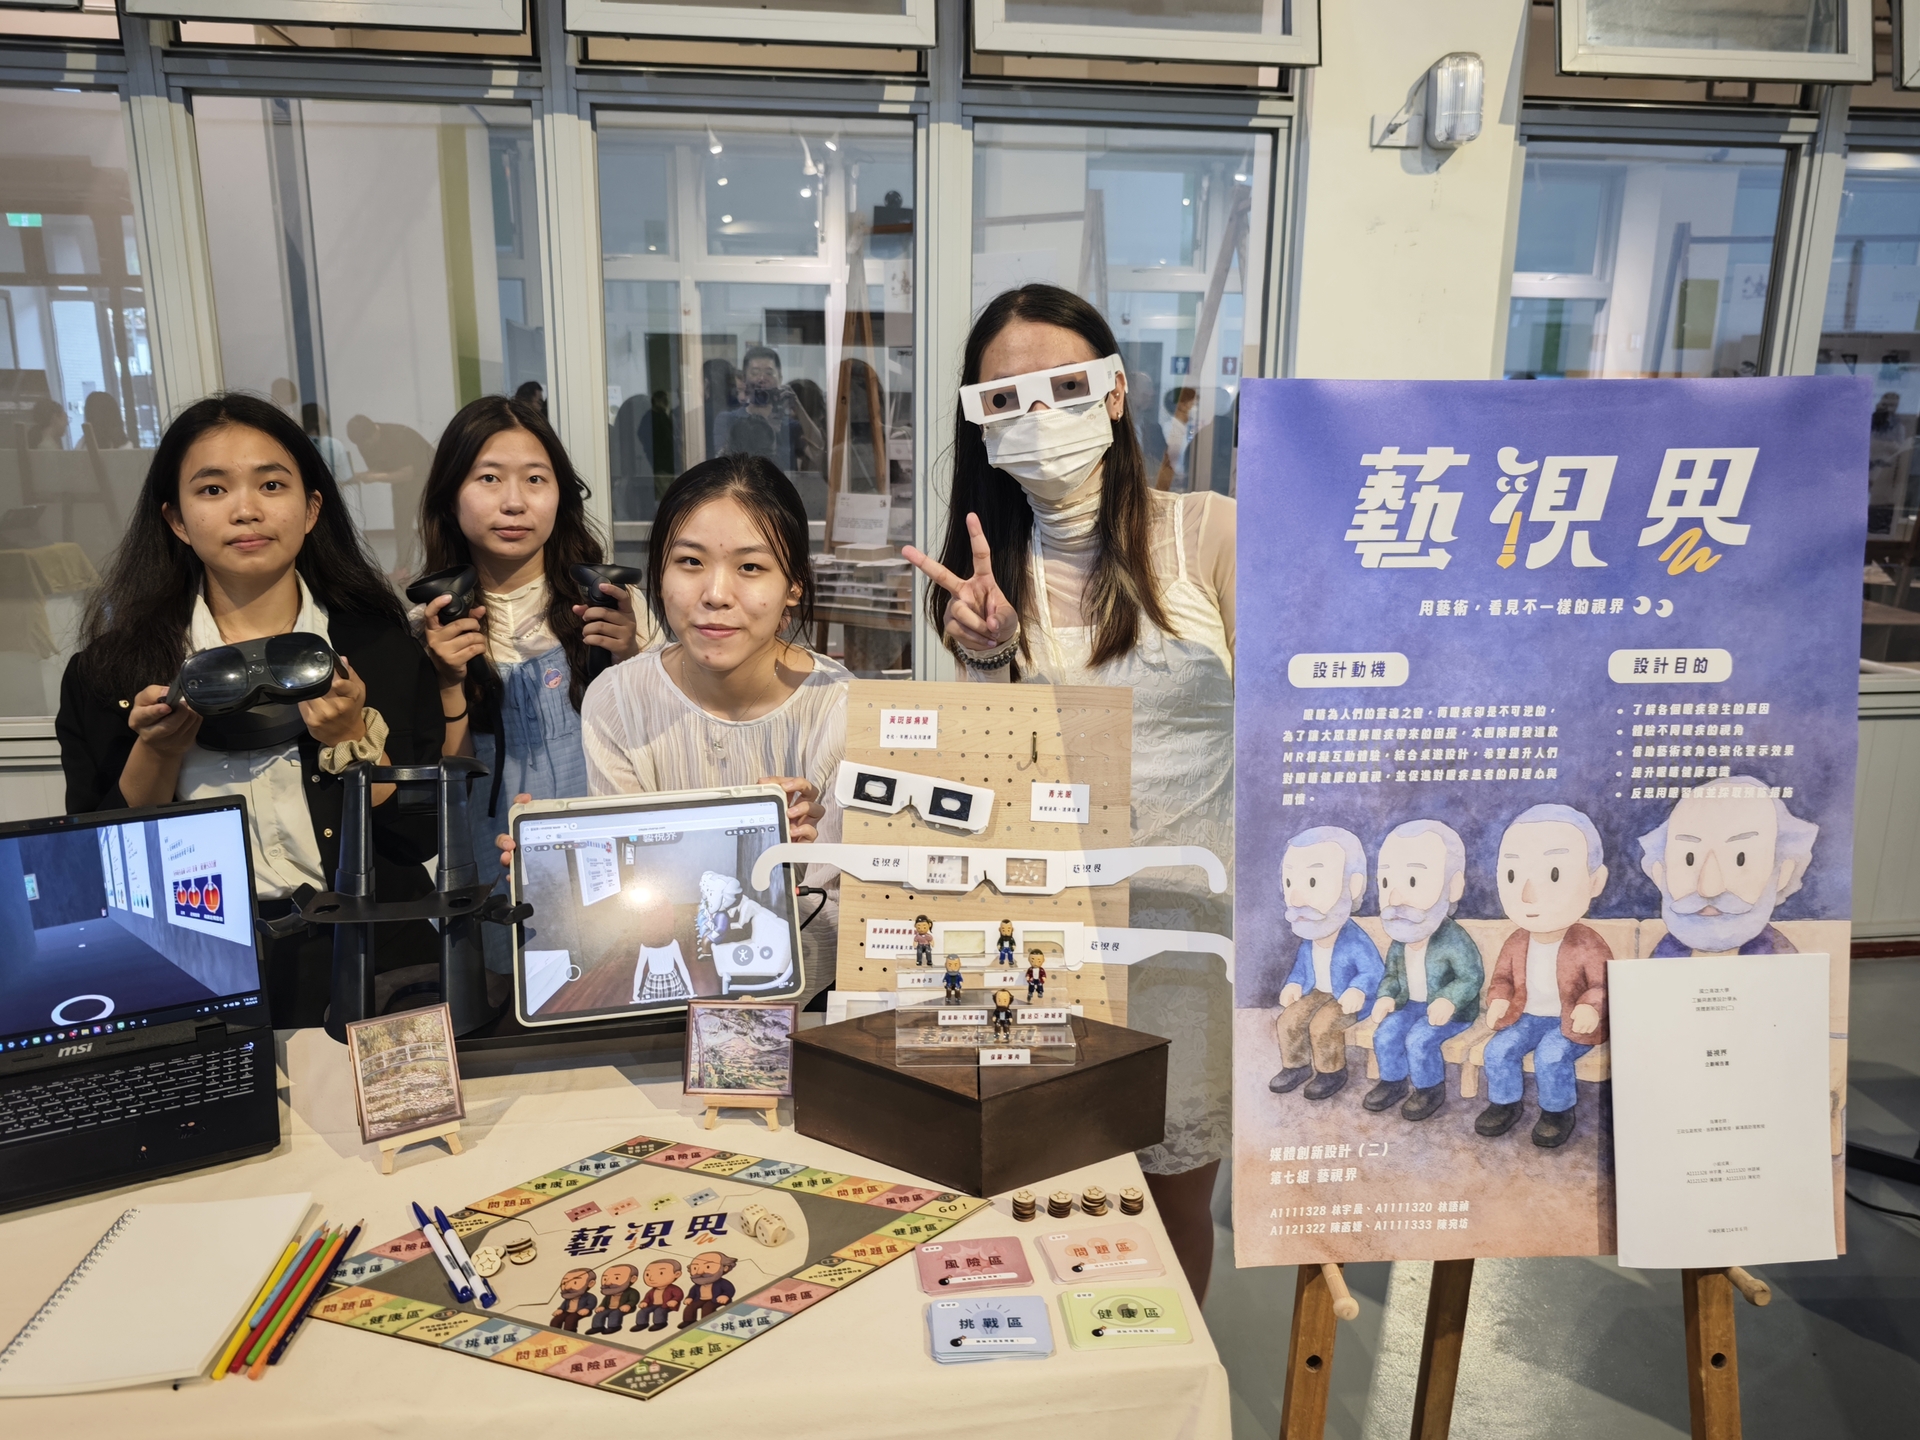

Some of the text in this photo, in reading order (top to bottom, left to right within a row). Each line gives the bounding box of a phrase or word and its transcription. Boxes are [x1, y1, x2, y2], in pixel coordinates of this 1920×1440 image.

[1344, 446, 1760, 575] 藝視界
[1312, 660, 1387, 679] 設計動機
[1633, 656, 1709, 675] 設計目的
[1632, 703, 1770, 716] 了解各個眼疾發生的原因
[1631, 724, 1744, 737] 體驗不同眼疾的視角
[1630, 766, 1731, 779] 提升眼睛健康意識
[1048, 789, 1072, 798] 青光眼
[58, 1042, 93, 1058] msi
[664, 1152, 702, 1161] 風險區
[578, 1159, 621, 1172] 挑戰區
[749, 1167, 791, 1178] 挑戰區
[1270, 1168, 1357, 1185] 第七組 藝視界
[534, 1179, 580, 1190] 健康區
[791, 1177, 834, 1189] 健康區
[836, 1185, 879, 1197] 問題區
[487, 1198, 533, 1210] 問題區
[886, 1193, 925, 1205] 風險區
[1270, 1205, 1327, 1218] A1111328
[564, 1212, 728, 1257] 藝視界
[892, 1223, 938, 1236] 健康區
[1270, 1223, 1326, 1236] A1121322
[853, 1244, 899, 1258] 問題區
[1073, 1242, 1132, 1258] 問題區
[944, 1255, 1004, 1270] 風險區
[769, 1291, 814, 1304] 風險區
[322, 1298, 374, 1313] 問題區
[369, 1310, 421, 1325] 健康區
[1097, 1307, 1160, 1320] 健康區
[720, 1315, 771, 1332] 挑戰區
[958, 1317, 1023, 1330] 挑戰區
[465, 1333, 517, 1349] 挑戰區
[515, 1344, 568, 1361] 問題區
[671, 1342, 723, 1360] 健康區
[569, 1358, 618, 1374] 風險區
